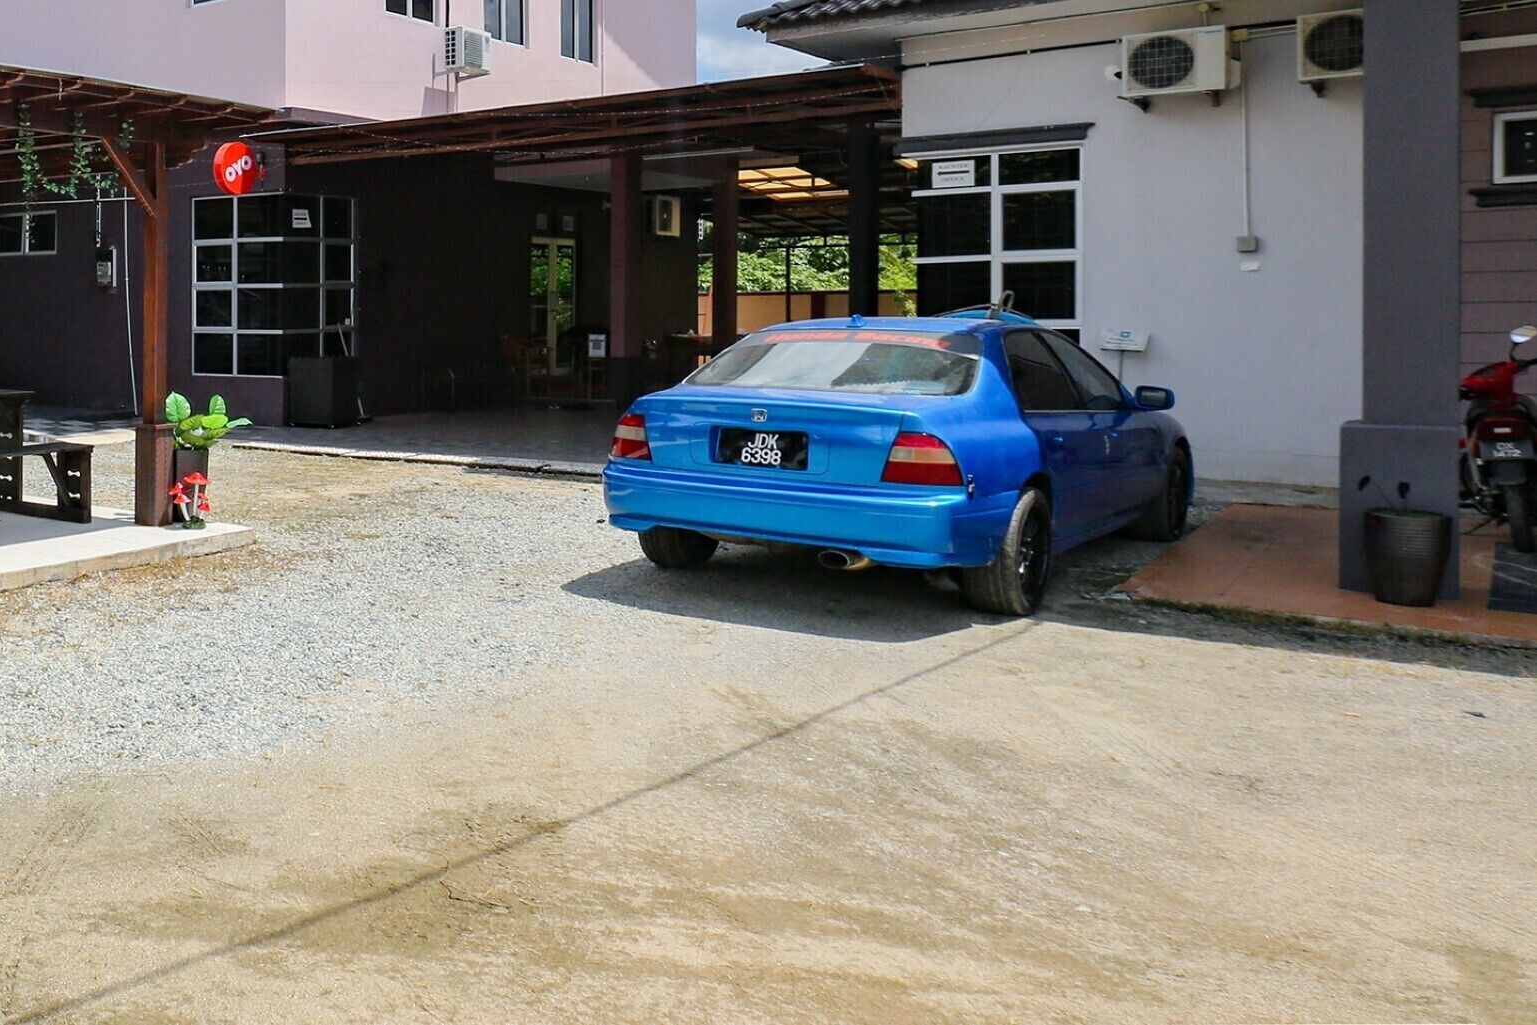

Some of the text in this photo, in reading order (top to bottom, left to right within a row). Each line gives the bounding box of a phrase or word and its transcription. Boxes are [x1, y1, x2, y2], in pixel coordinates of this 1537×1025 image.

[225, 155, 252, 182] OYO
[747, 433, 779, 449] JDK
[741, 447, 782, 465] 6398
